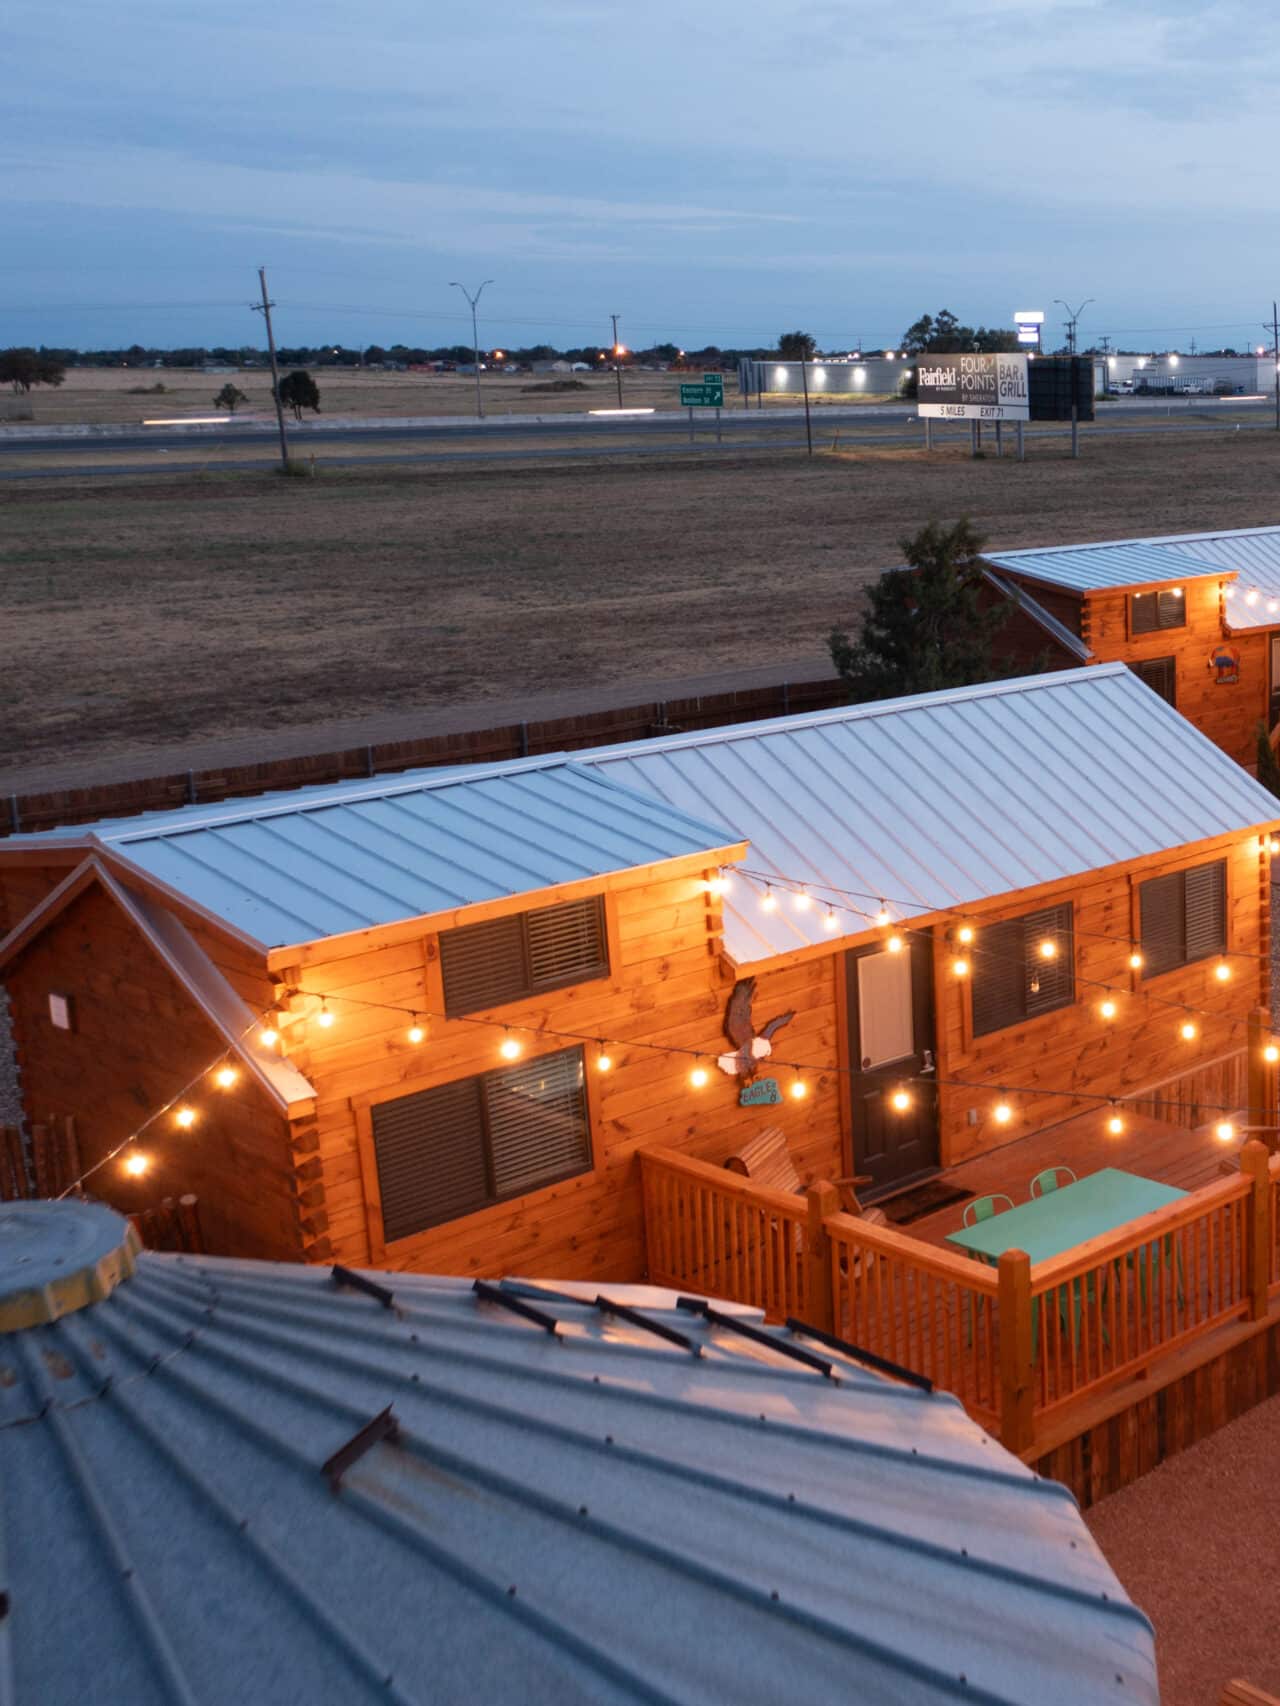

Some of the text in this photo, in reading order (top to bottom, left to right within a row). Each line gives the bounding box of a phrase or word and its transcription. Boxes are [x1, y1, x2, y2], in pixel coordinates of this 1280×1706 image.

[960, 357, 987, 373] FOUR
[1000, 364, 1018, 380] BAR
[918, 367, 957, 386] Fairfield
[961, 374, 996, 391] POINTS
[999, 381, 1027, 398] GRILL
[940, 406, 965, 416] 5 MILES
[980, 407, 1004, 417] EXIT 71
